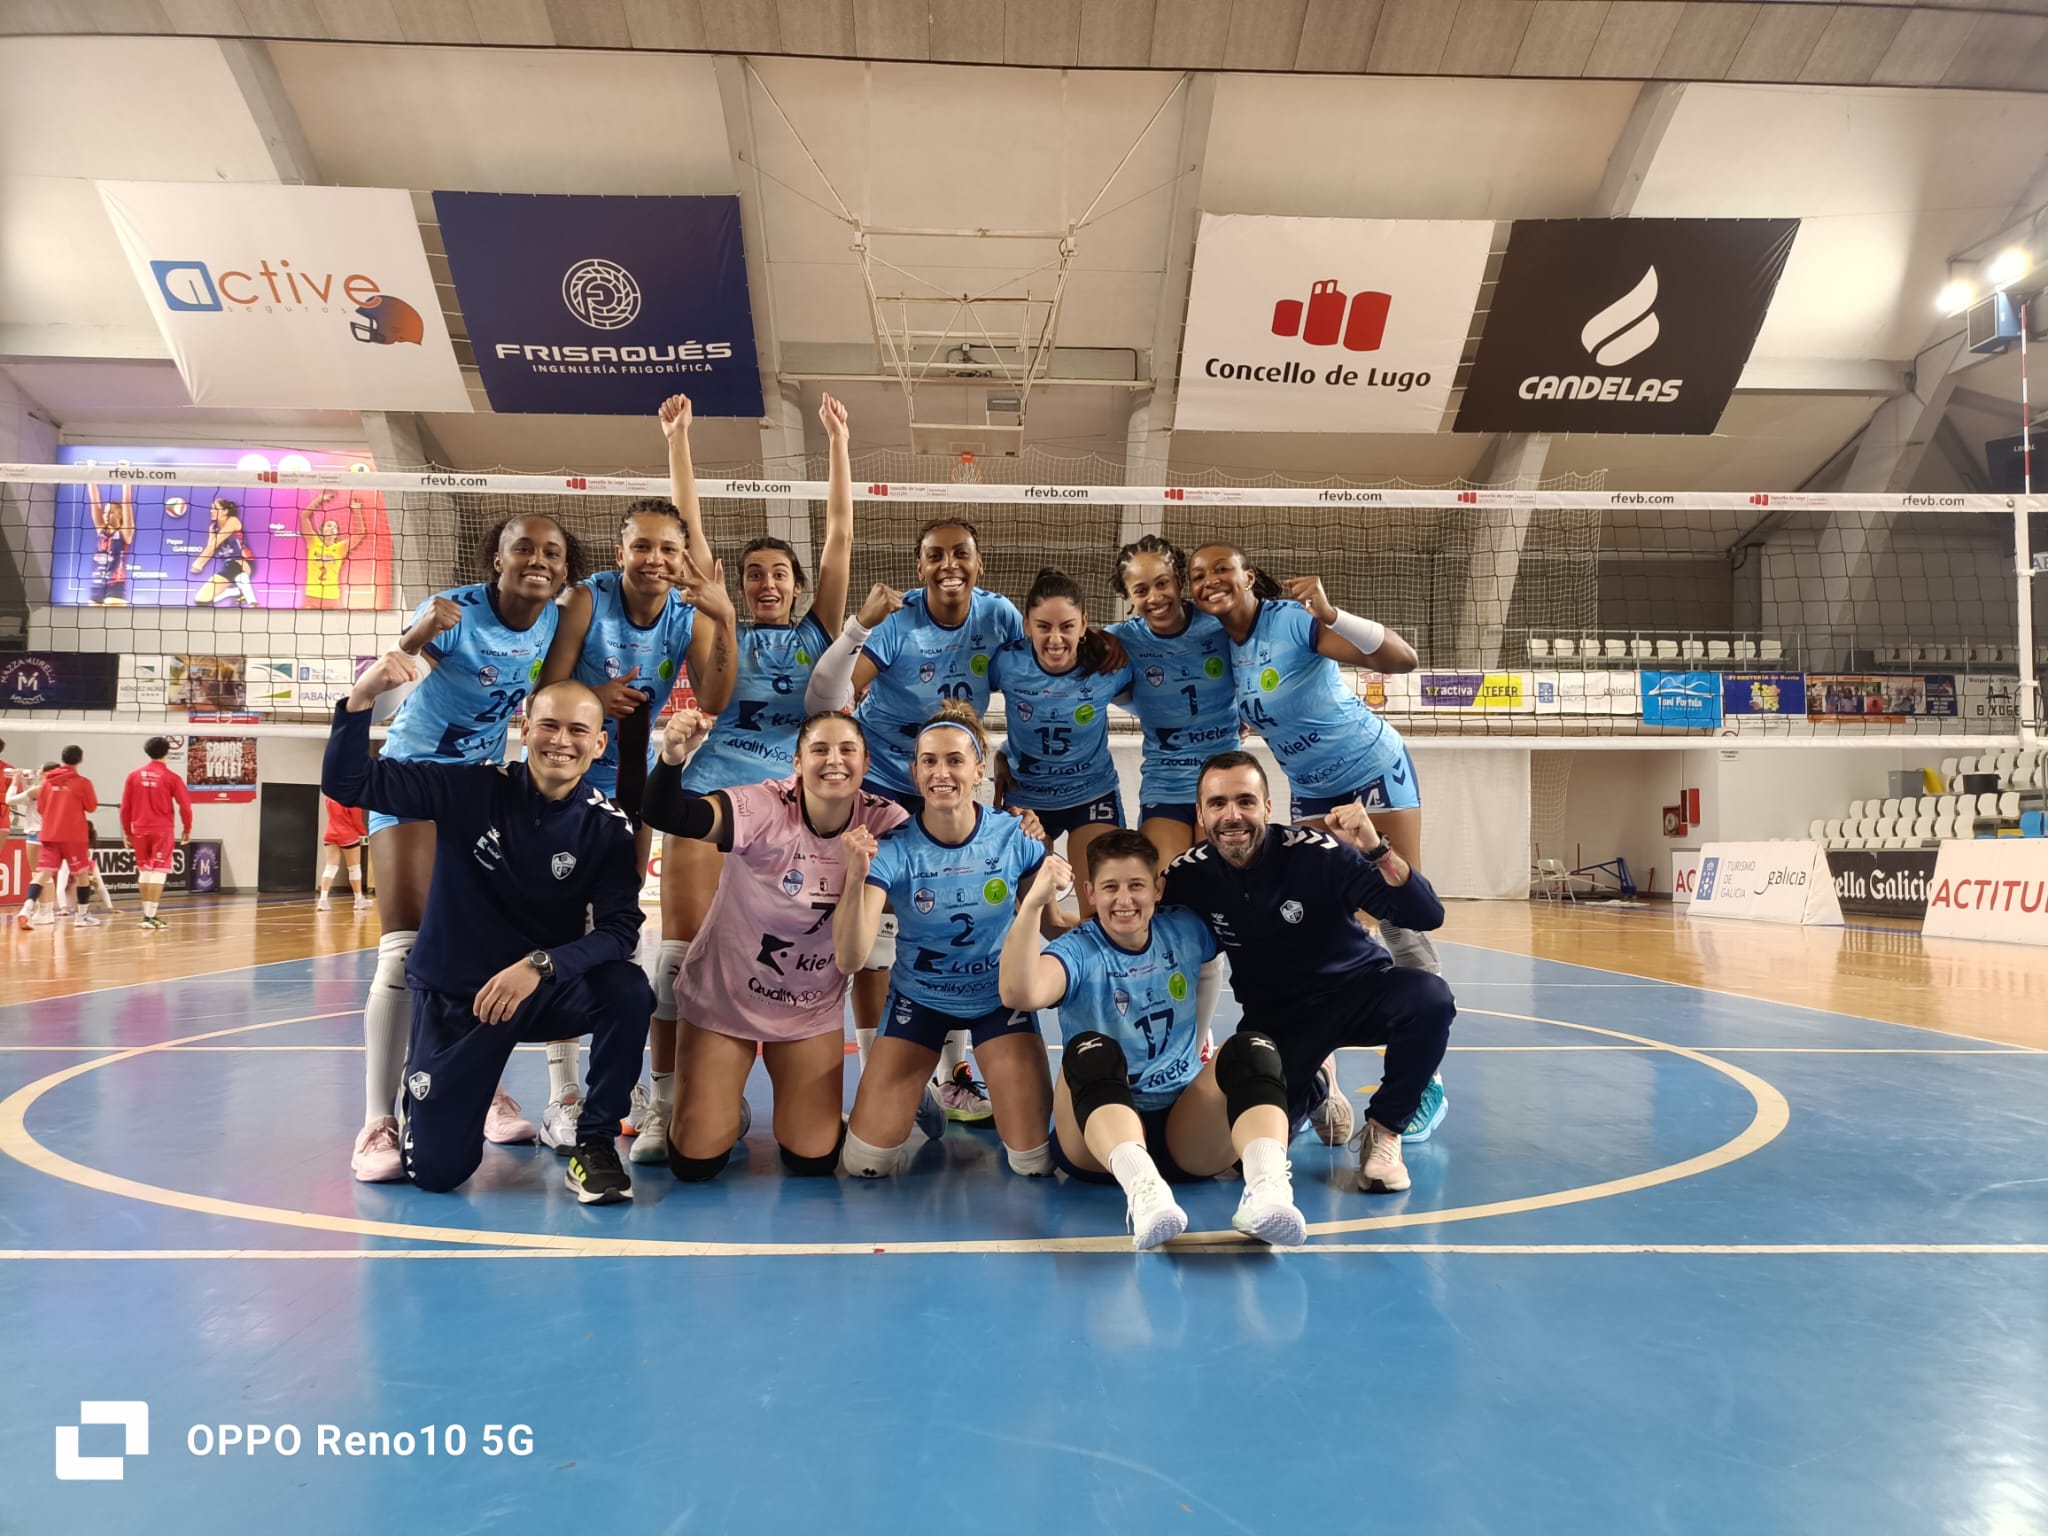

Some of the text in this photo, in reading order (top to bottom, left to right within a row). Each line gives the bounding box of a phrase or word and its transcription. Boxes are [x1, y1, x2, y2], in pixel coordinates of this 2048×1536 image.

[495, 340, 733, 362] FRISAQUÉS
[533, 363, 713, 374] INGENIERÍA FRIGORÍFICA
[1205, 358, 1432, 392] Concello de Lugo
[1518, 375, 1683, 402] CANDELAS
[109, 467, 177, 480] rfevb.com
[421, 475, 487, 487] rfevb.com
[726, 481, 791, 493] rfevb.com
[1024, 486, 1089, 498] rfevb.com
[1318, 490, 1382, 502] rfevb.com
[1611, 493, 1674, 505] rfevb.com
[1902, 495, 1965, 507] rfevb.com
[937, 682, 974, 701] 10
[1441, 685, 1473, 697] activa
[1485, 686, 1518, 697] TEFER
[1180, 684, 1199, 716] 1
[1240, 698, 1279, 730] 14
[1034, 727, 1072, 756] 15
[1189, 727, 1228, 744] kiele
[1277, 730, 1321, 757] kiele
[1089, 802, 1115, 820] 15
[1727, 861, 1757, 872] TURISMO
[1723, 874, 1734, 885] DE
[1720, 887, 1746, 898] GALICIA
[1931, 878, 2048, 913] ACTITU
[803, 902, 836, 935] 7
[950, 913, 975, 947] 2
[1134, 1008, 1174, 1060] 17
